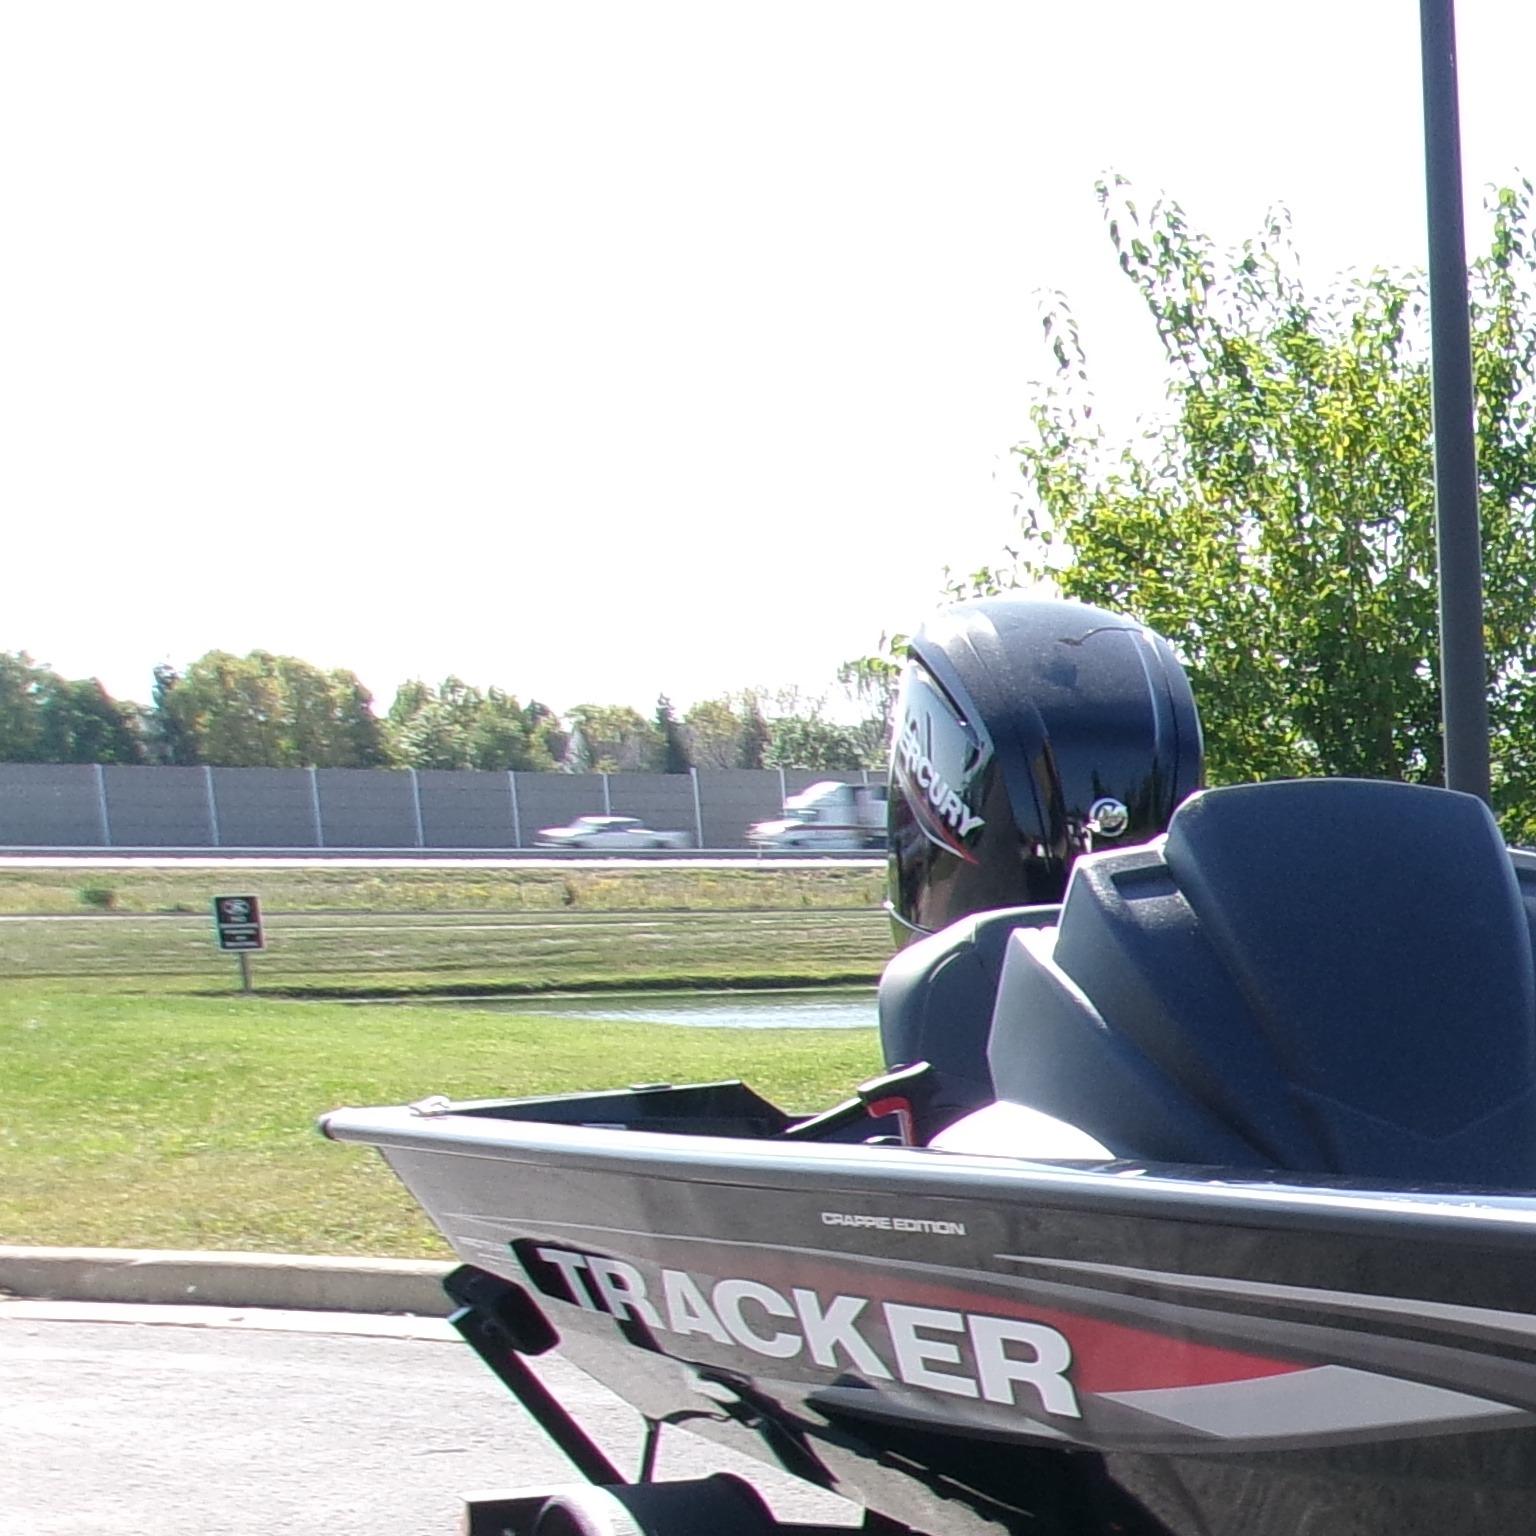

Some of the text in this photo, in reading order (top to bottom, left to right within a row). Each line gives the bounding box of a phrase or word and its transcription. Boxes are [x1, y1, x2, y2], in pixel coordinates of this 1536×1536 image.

[821, 1212, 965, 1236] CRAPPIE EDITION
[537, 1247, 1082, 1419] TRACKER
